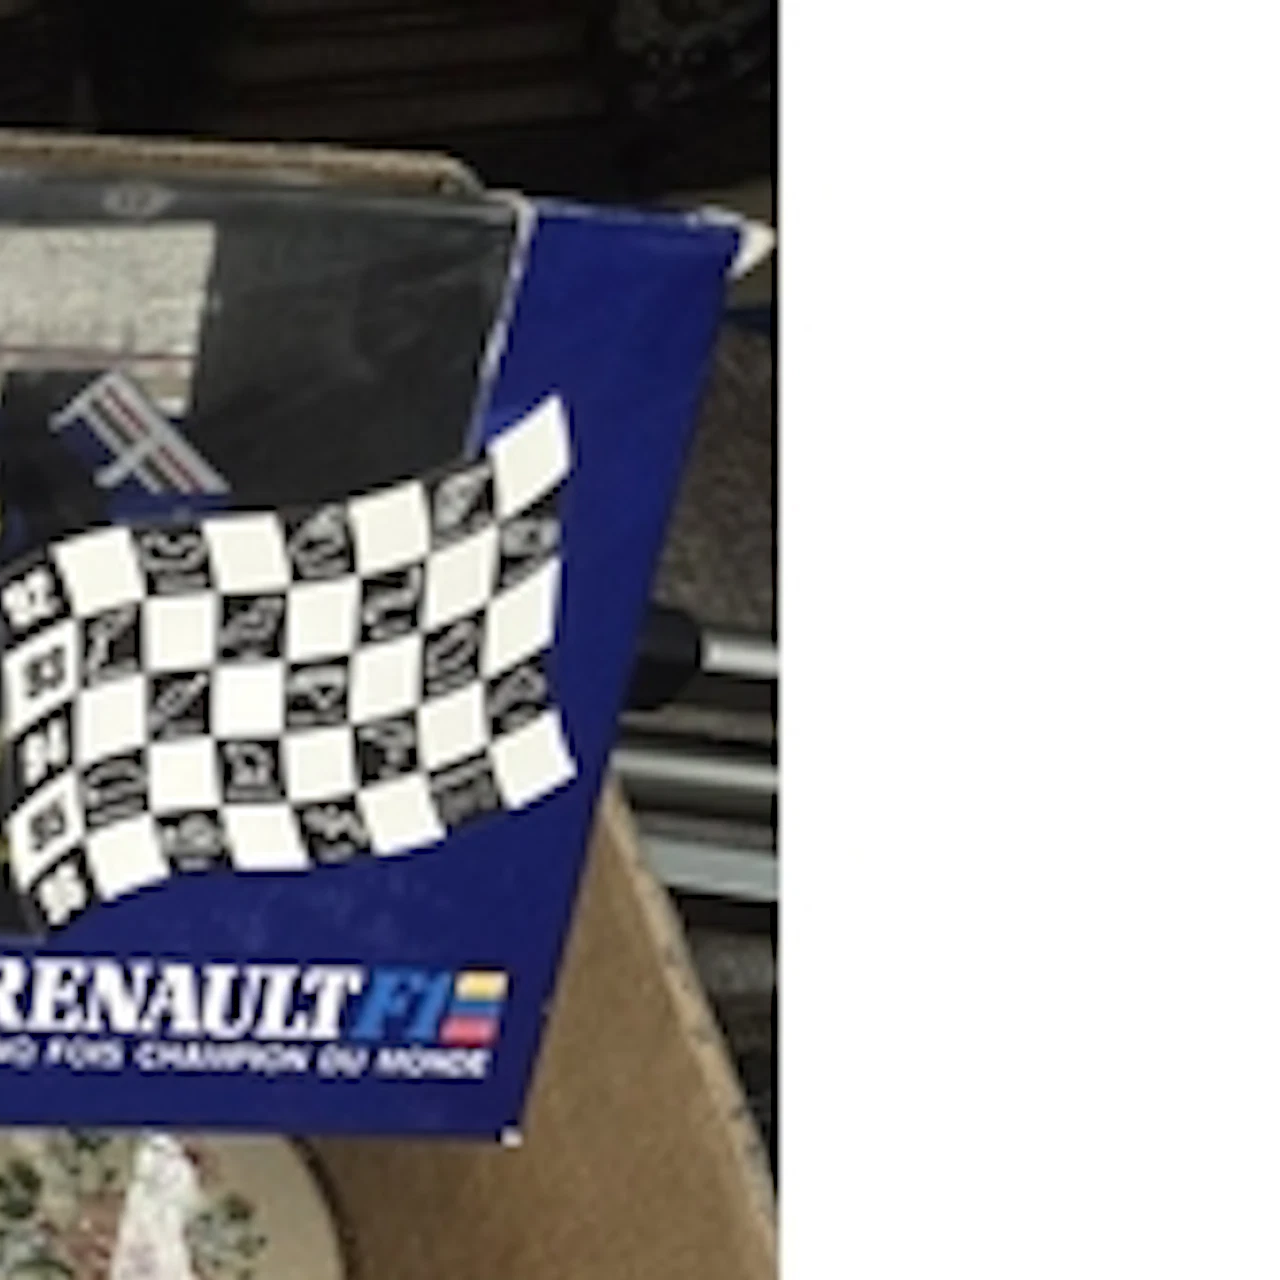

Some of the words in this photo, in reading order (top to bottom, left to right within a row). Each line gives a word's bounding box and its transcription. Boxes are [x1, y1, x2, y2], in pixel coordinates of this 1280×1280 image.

[46, 1039, 121, 1069] FOIS
[138, 1042, 308, 1075] CHAMPION
[376, 1050, 493, 1080] MONDE
